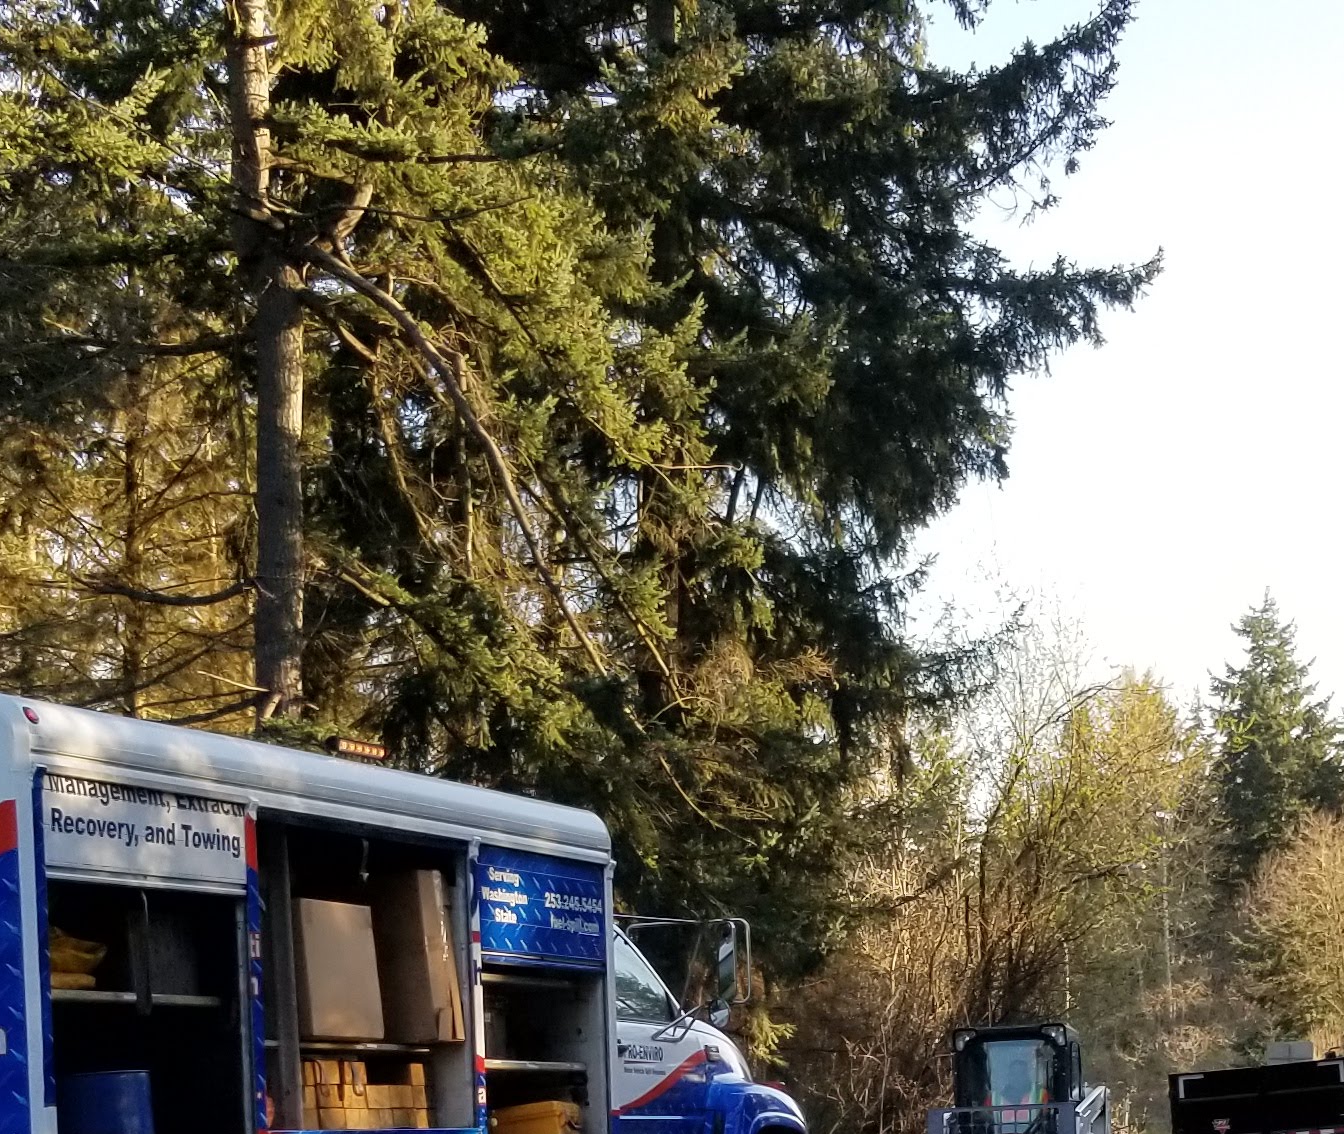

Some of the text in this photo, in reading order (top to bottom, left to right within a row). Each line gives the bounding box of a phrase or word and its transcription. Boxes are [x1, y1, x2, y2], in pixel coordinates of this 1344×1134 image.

[51, 807, 241, 858] Recovery, and Towing
[488, 867, 520, 887] Serving
[481, 886, 528, 906] Washington
[544, 892, 602, 914] 253.245.5454
[495, 908, 517, 924] State
